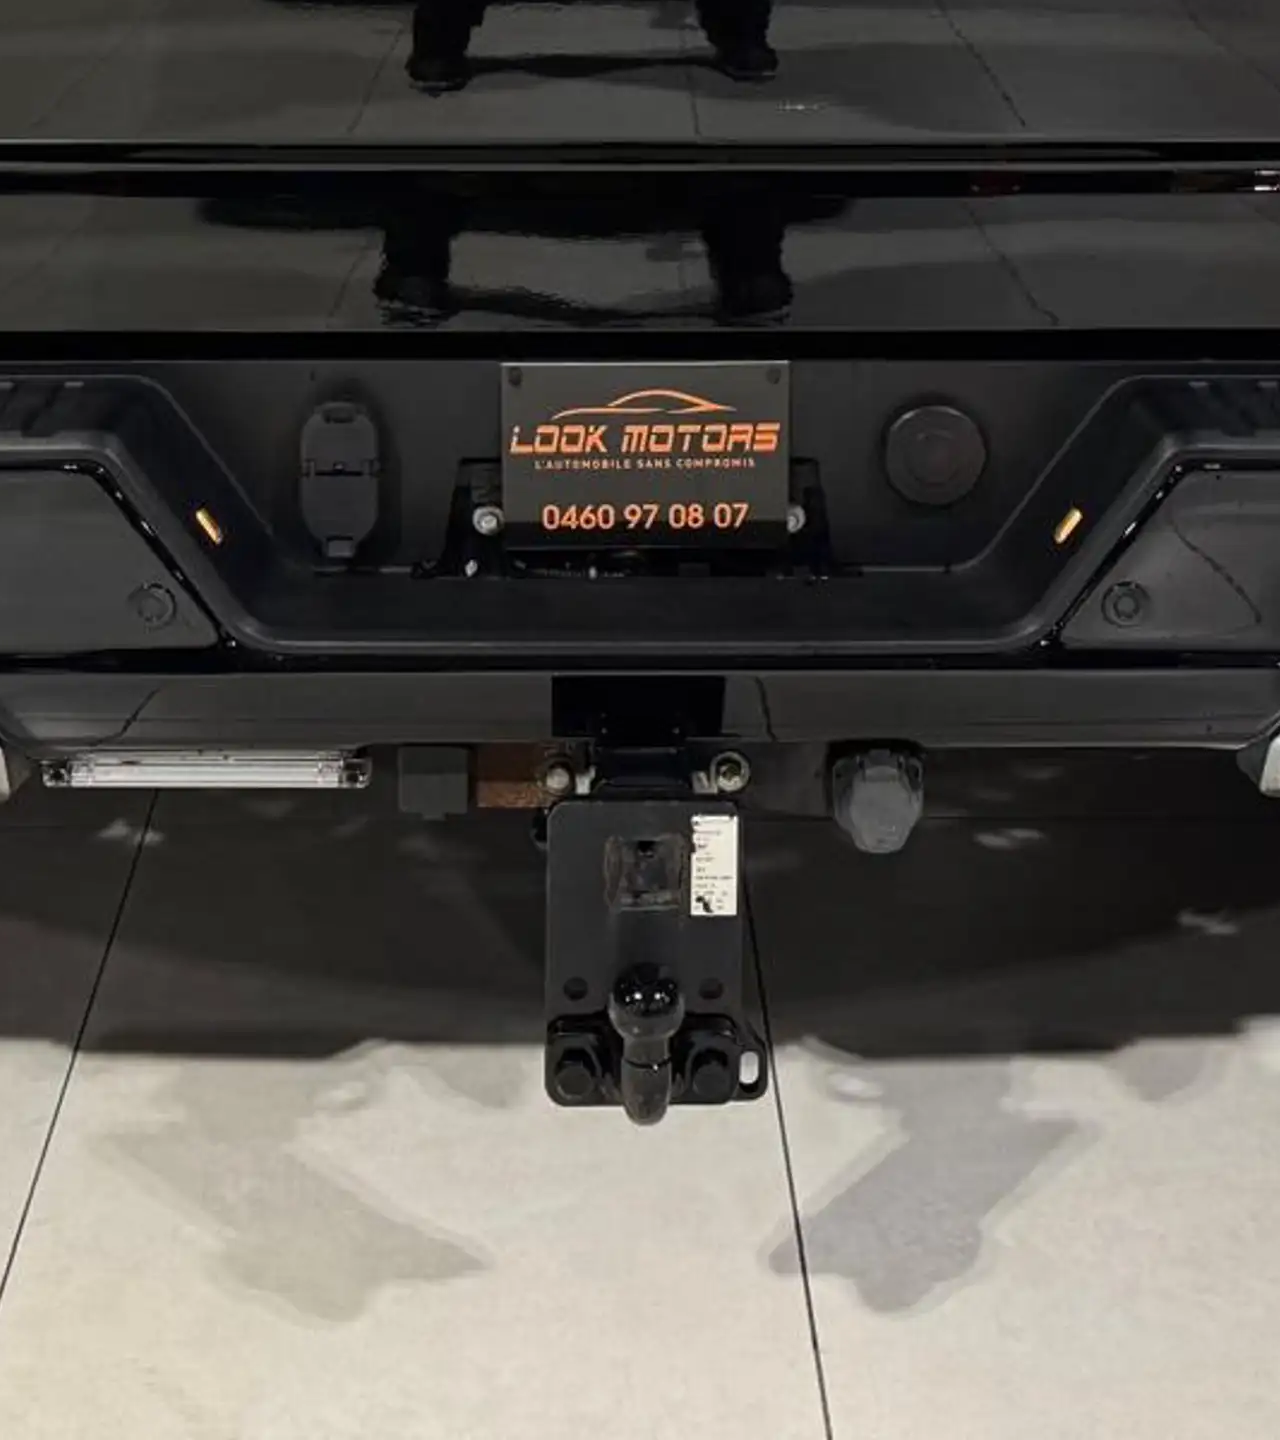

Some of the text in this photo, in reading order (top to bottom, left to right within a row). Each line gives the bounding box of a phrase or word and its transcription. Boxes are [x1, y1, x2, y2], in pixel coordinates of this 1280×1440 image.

[509, 422, 781, 454] LOOK MOTORS
[534, 457, 756, 470] L'AUTOMOBILE SANS COMPROMIS
[542, 503, 749, 530] 0460 97 08 07
